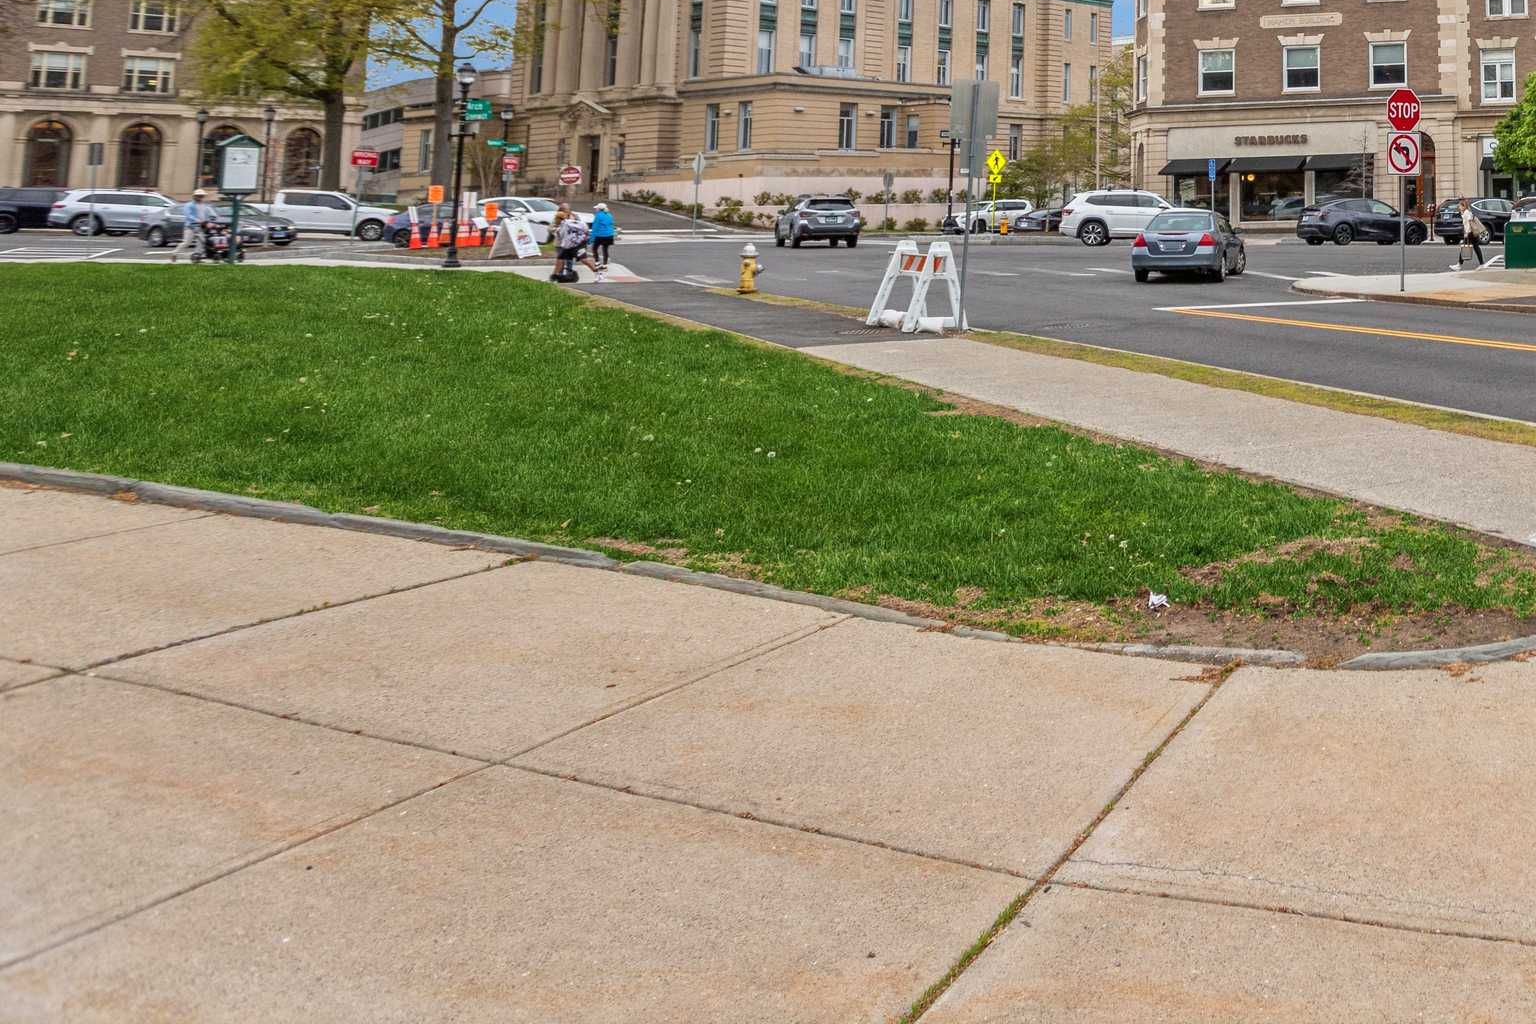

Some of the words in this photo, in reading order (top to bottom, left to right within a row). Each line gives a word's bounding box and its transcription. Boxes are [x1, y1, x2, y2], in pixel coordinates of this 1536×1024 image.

[1268, 17, 1295, 26] MAHER
[1299, 16, 1335, 25] BUILDING
[466, 102, 483, 110] Arch
[1389, 102, 1418, 118] STOP
[1234, 134, 1308, 146] STARBUCKS
